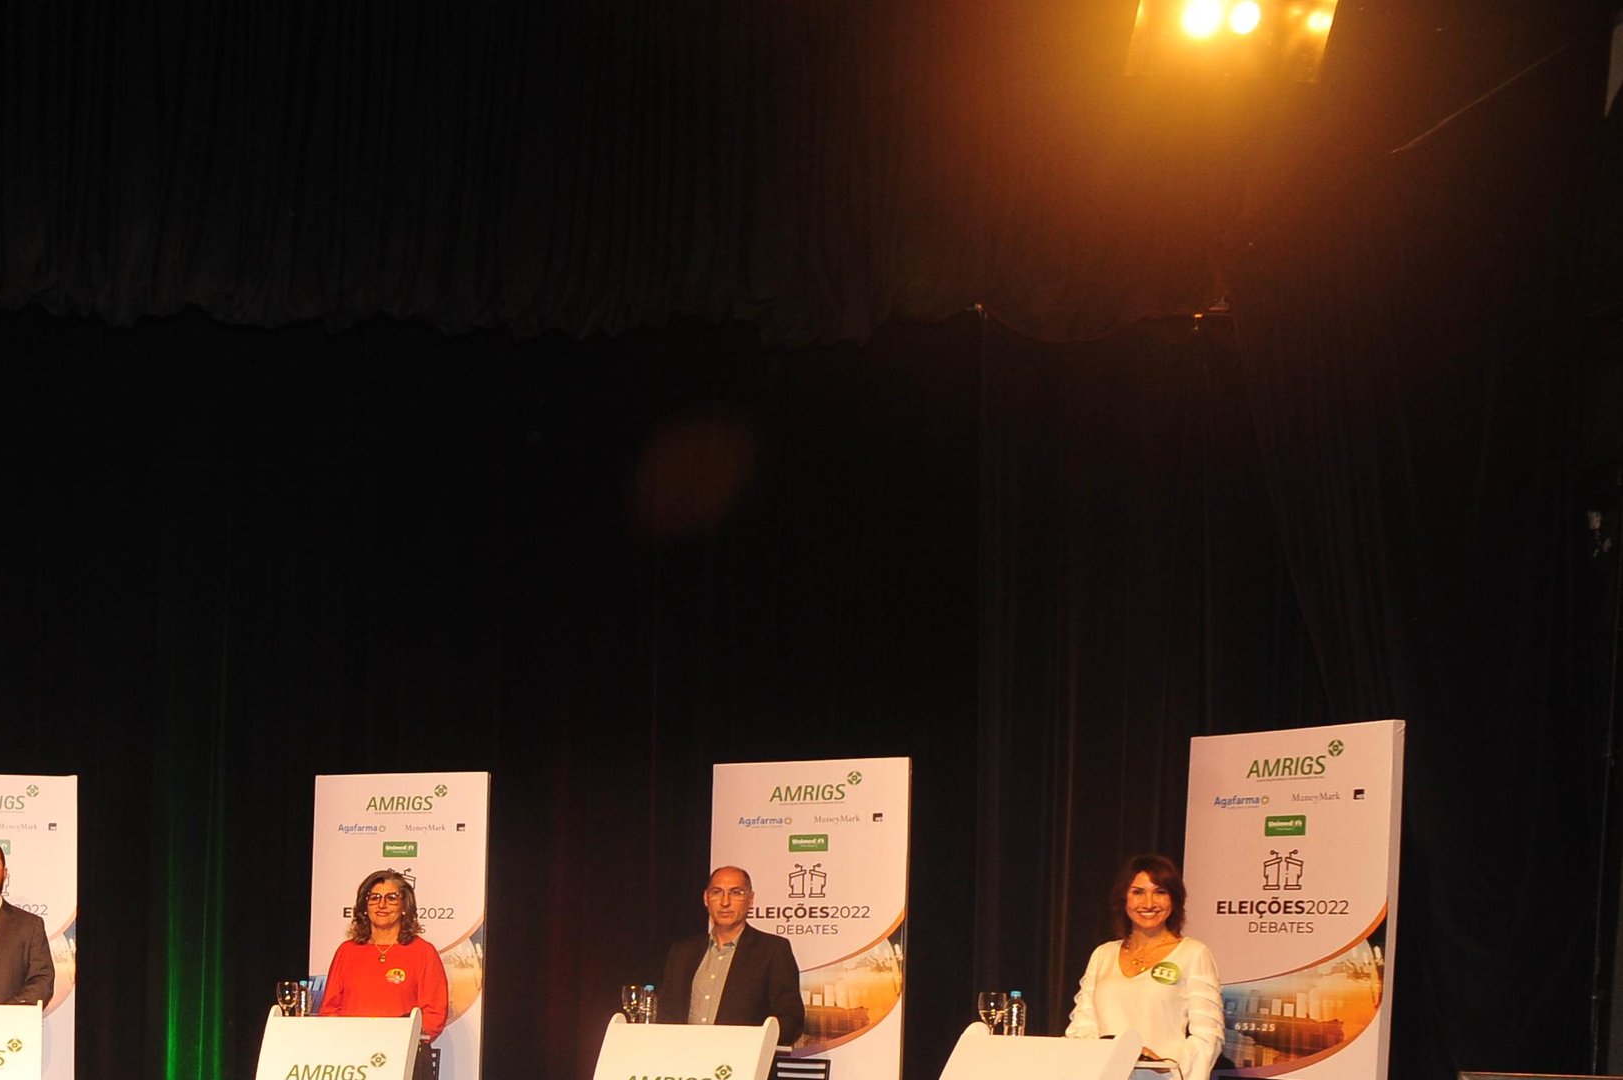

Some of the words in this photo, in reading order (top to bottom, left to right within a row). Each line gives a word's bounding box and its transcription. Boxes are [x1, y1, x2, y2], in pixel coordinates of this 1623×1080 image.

[1247, 755, 1326, 779] AMRIGS
[770, 784, 845, 802] AMRIGS
[1292, 793, 1341, 804] MoneyMark
[366, 796, 433, 811] AMRIGS
[1214, 795, 1260, 808] Agafarma
[738, 817, 783, 827] Agafarma
[814, 815, 859, 825] MoneyMark
[339, 824, 377, 833] Agafarma
[1216, 897, 1349, 918] ELEIÇÕES2022
[777, 925, 838, 935] DEBATES
[1249, 922, 1313, 933] DEBATES
[1235, 1023, 1275, 1031] 653.25
